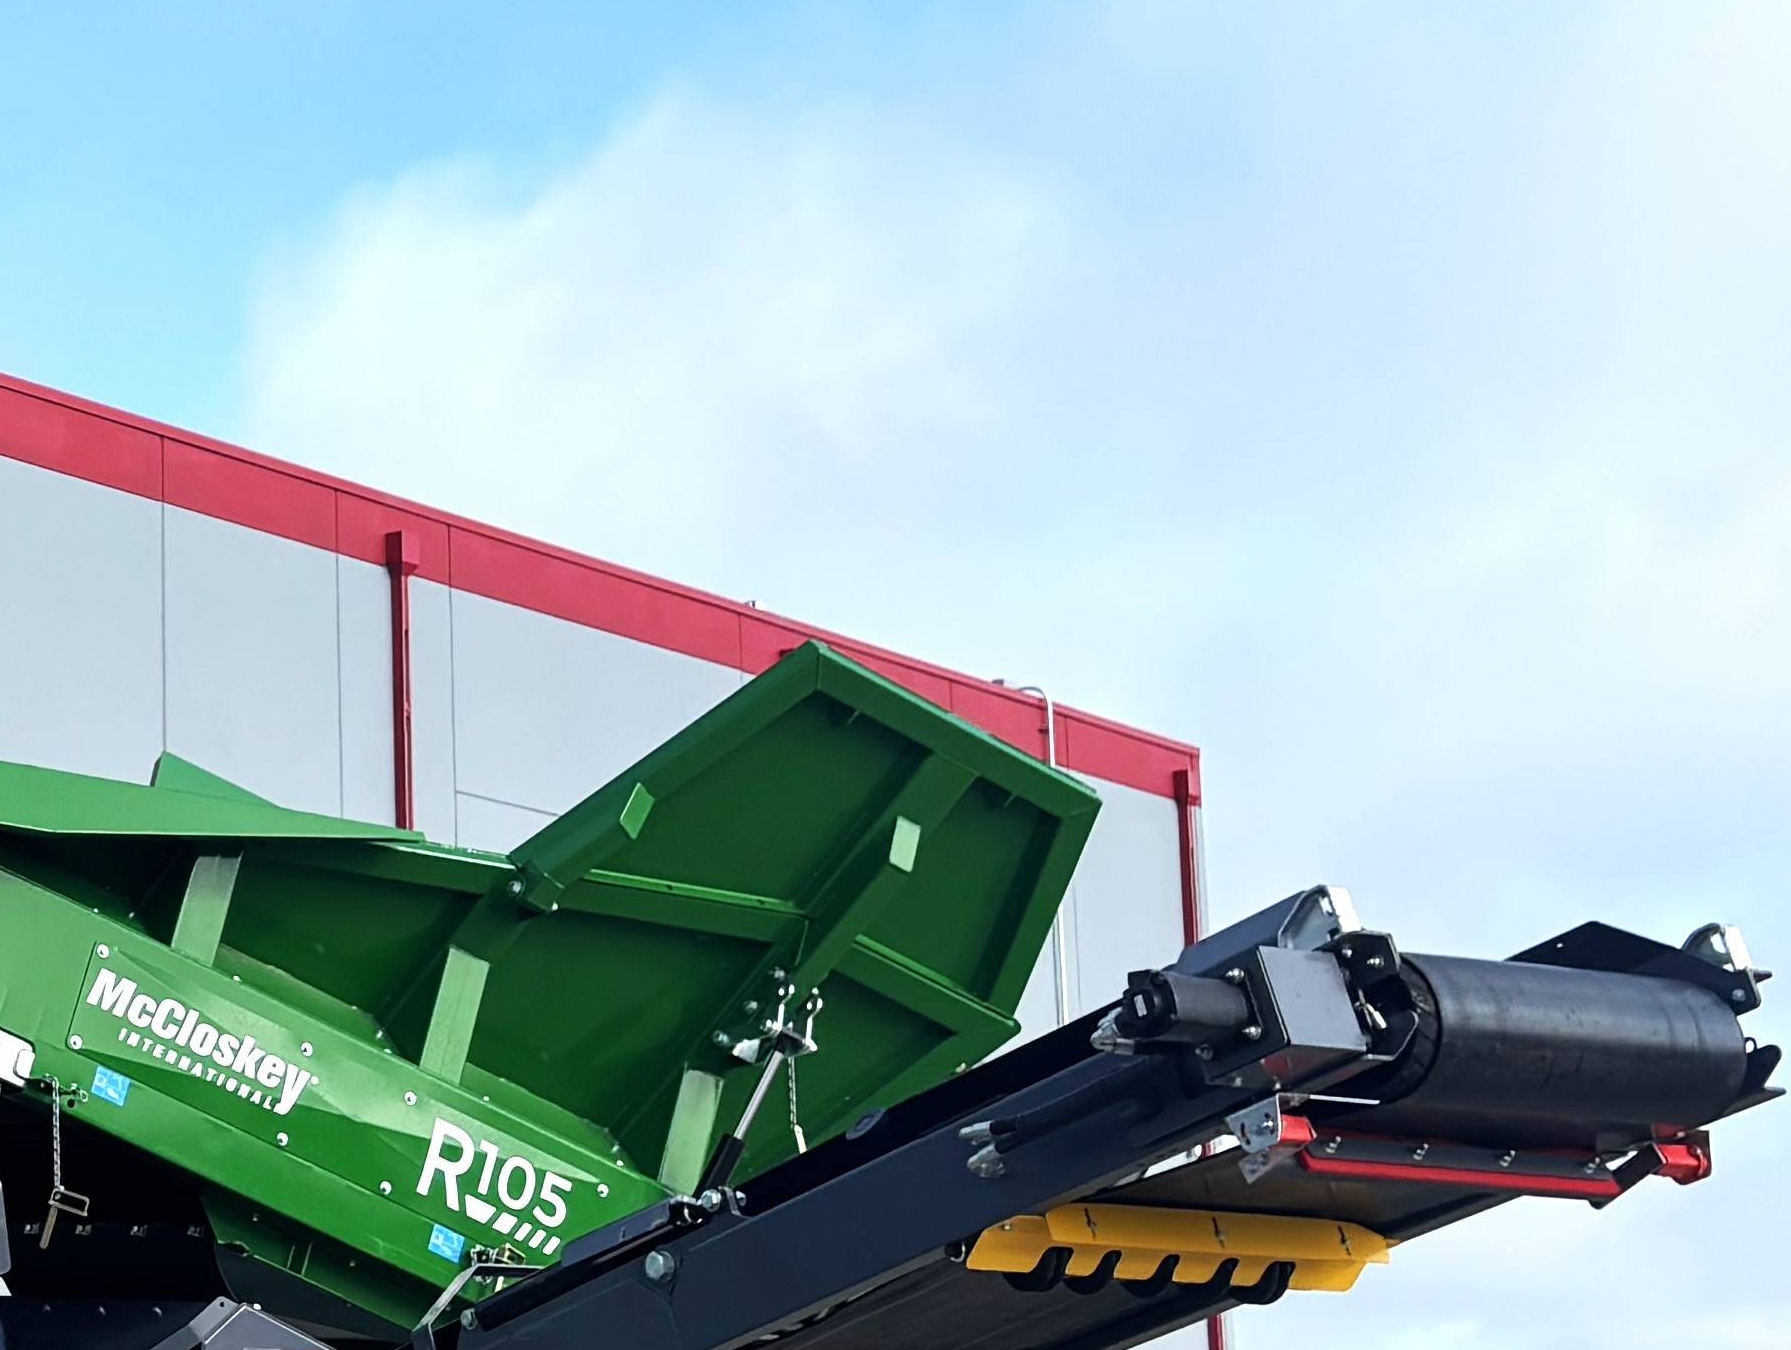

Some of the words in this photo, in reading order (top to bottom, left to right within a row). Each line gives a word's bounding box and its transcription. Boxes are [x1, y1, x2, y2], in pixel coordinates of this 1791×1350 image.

[85, 967, 311, 1116] McCloskey
[118, 1027, 273, 1111] INTERNATIONAL
[416, 1116, 573, 1228] R105
